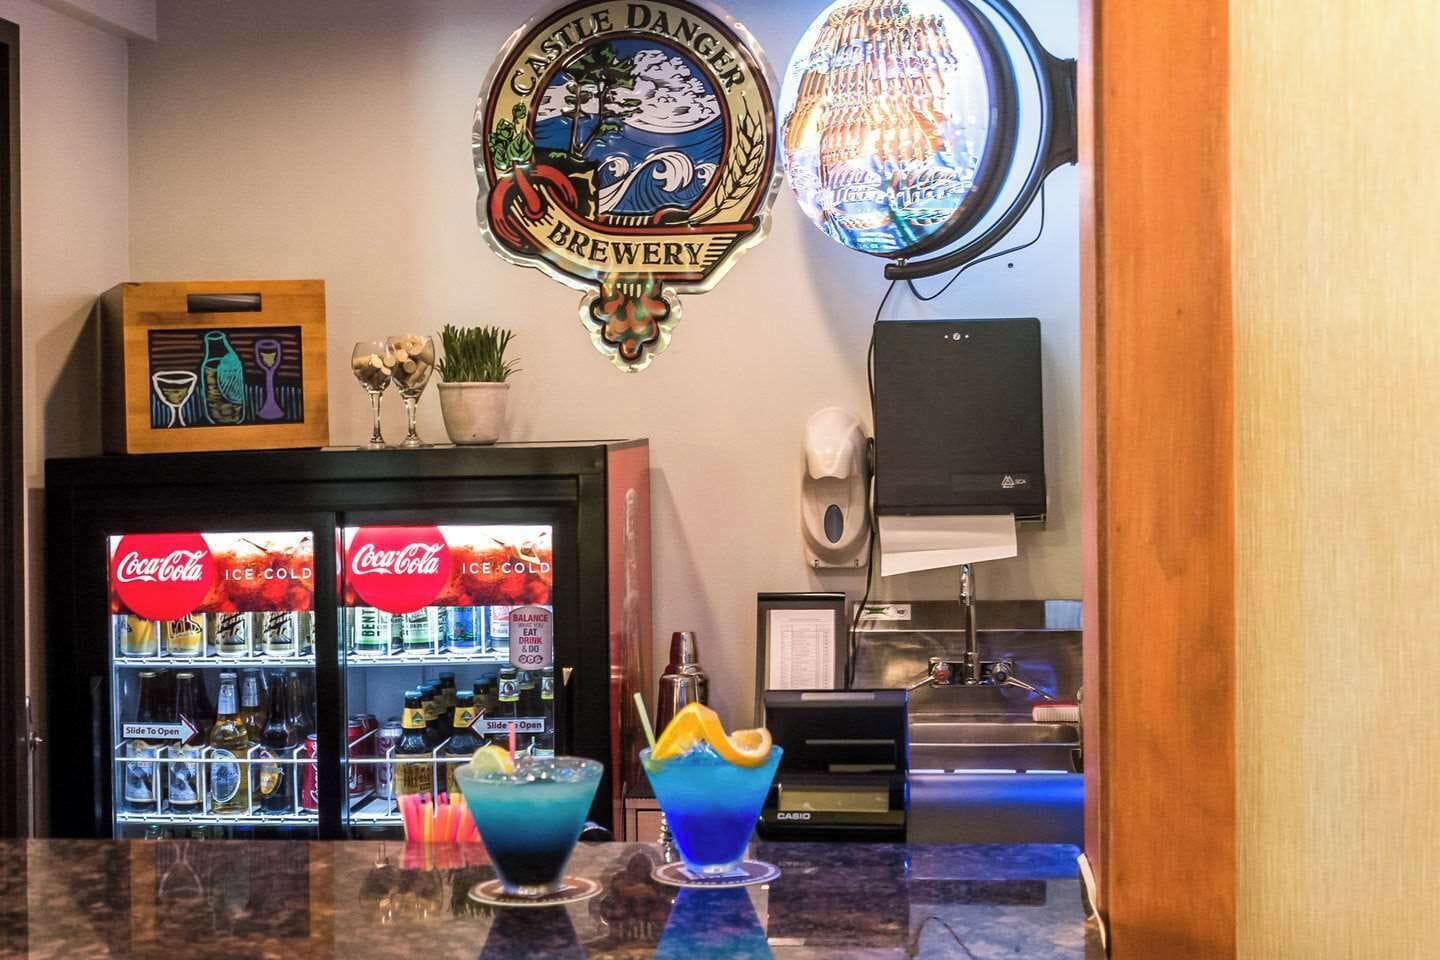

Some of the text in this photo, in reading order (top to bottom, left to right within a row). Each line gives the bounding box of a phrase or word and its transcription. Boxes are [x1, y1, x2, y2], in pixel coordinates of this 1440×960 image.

[510, 3, 745, 97] CASTLE DANGER
[547, 220, 704, 266] BREWERY
[351, 542, 445, 576] Coca-Cola
[117, 549, 208, 583] Coca-Cola
[462, 561, 551, 575] ICE COLD
[224, 567, 313, 581] ICE COLD
[361, 608, 376, 637] BENT
[513, 613, 549, 622] BALANCE
[523, 628, 538, 637] EAT
[519, 636, 543, 645] DRINK
[528, 645, 540, 653] DO
[126, 726, 180, 736] Slide To Open
[486, 720, 507, 729] Slide
[519, 721, 542, 730] Open
[777, 812, 811, 820] CASIO
